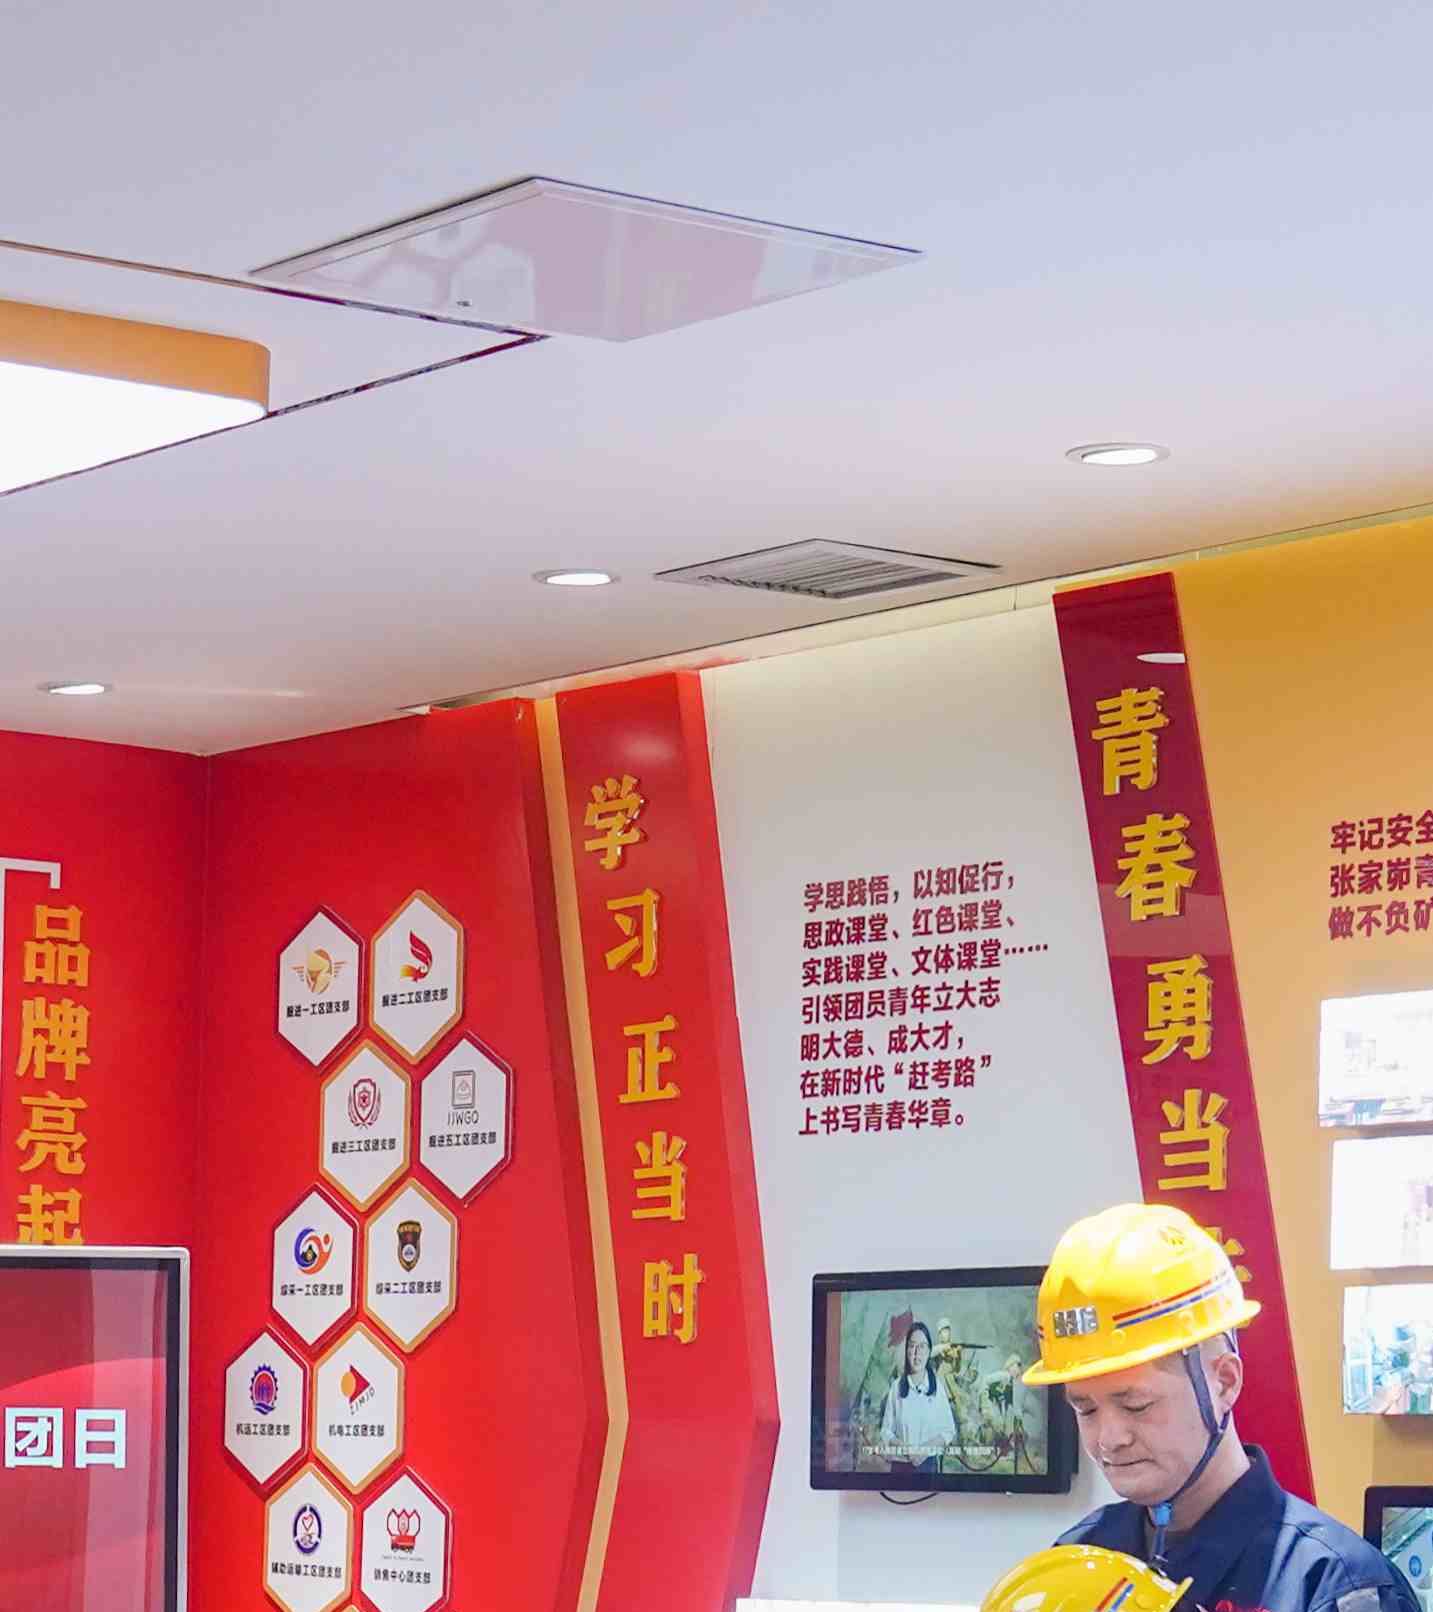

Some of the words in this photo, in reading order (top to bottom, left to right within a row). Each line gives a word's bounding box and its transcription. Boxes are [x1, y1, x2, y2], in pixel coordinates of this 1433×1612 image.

[803, 861, 1015, 913] 学思践悟，以知促行，
[803, 899, 1015, 950] 思政课堂、红色课堂、
[802, 938, 1049, 988] 实践课堂、文体课堂……
[801, 977, 1001, 1025] 引领团员青年立大志
[584, 773, 706, 1344] 学习正当时
[800, 1020, 965, 1062] 明大德、成大才，
[15, 904, 92, 1246] 品牌亮起
[800, 1054, 992, 1099] 在新时代“赶考路”
[798, 1097, 965, 1136] 上书写青春华章。
